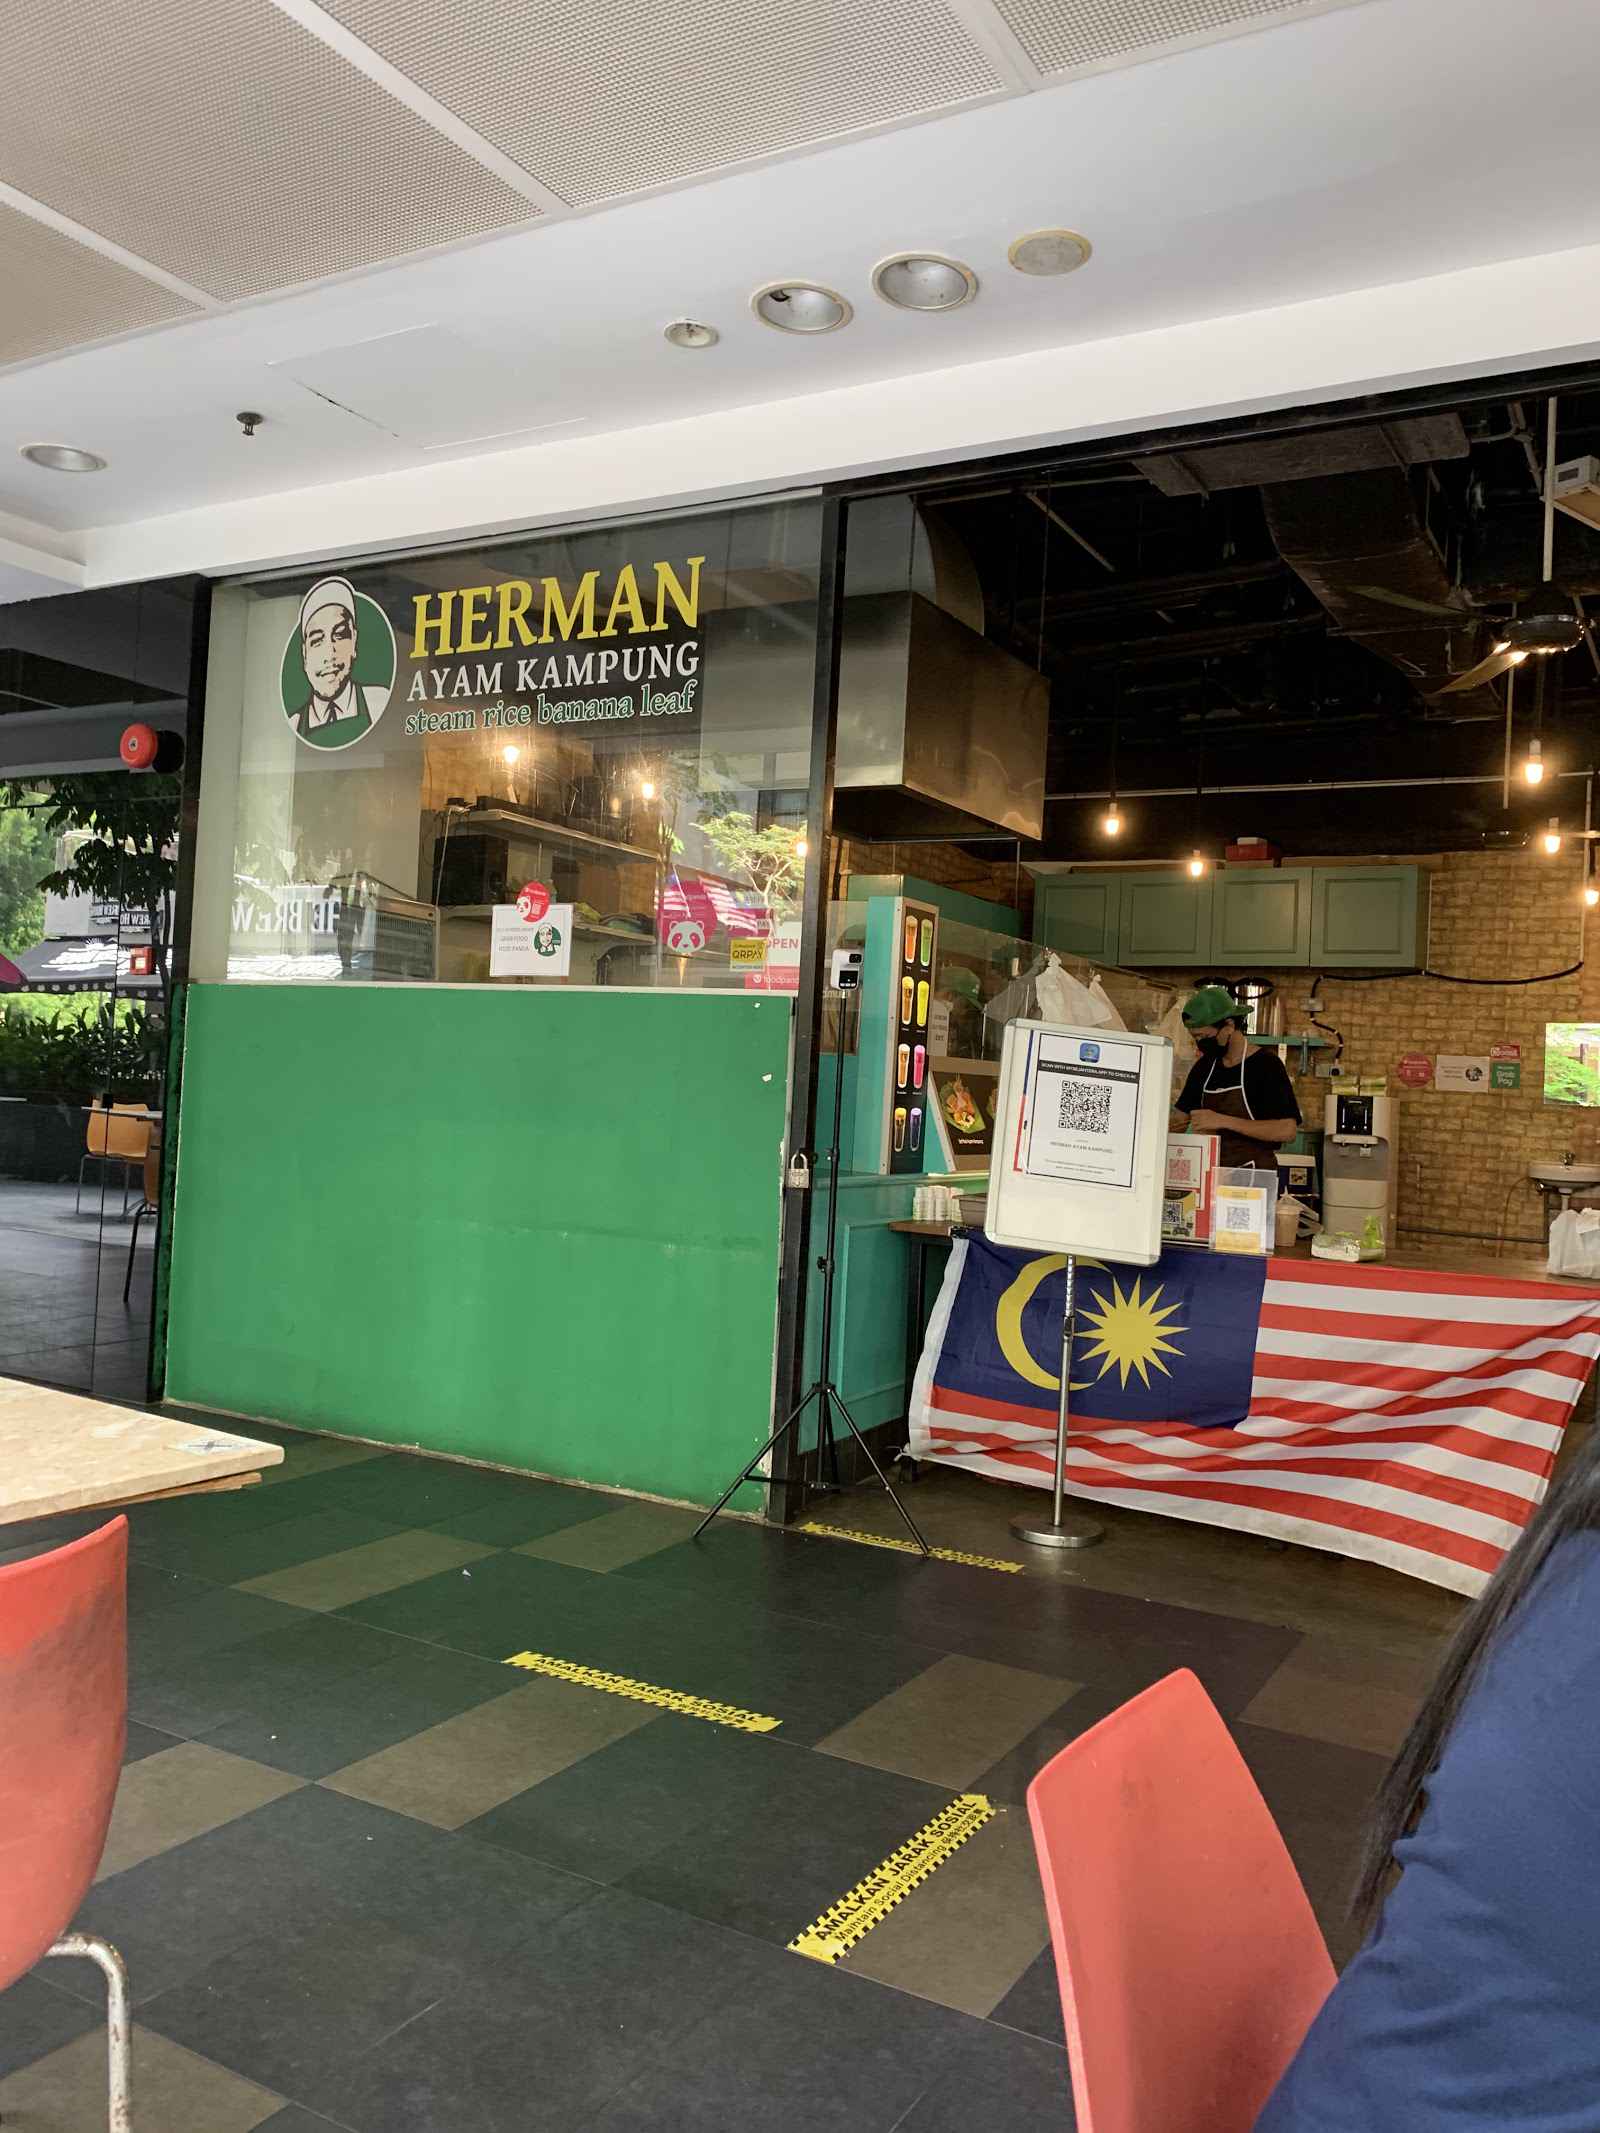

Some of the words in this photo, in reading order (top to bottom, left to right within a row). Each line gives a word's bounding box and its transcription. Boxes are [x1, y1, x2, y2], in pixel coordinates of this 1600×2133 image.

[409, 555, 705, 659] HERMAN
[404, 706, 477, 736] steam
[483, 701, 530, 728] rice
[536, 690, 634, 725] banana
[641, 679, 698, 716] leaf
[406, 659, 502, 702] AYAM
[516, 641, 699, 691] KAMPUNG
[815, 1878, 890, 1940] AMALKAN
[889, 1839, 934, 1876] JARAK
[930, 1801, 977, 1838] SOSIAL
[835, 1906, 877, 1942] Maintain
[874, 1881, 903, 1906] Social
[902, 1844, 947, 1882] Distancing
